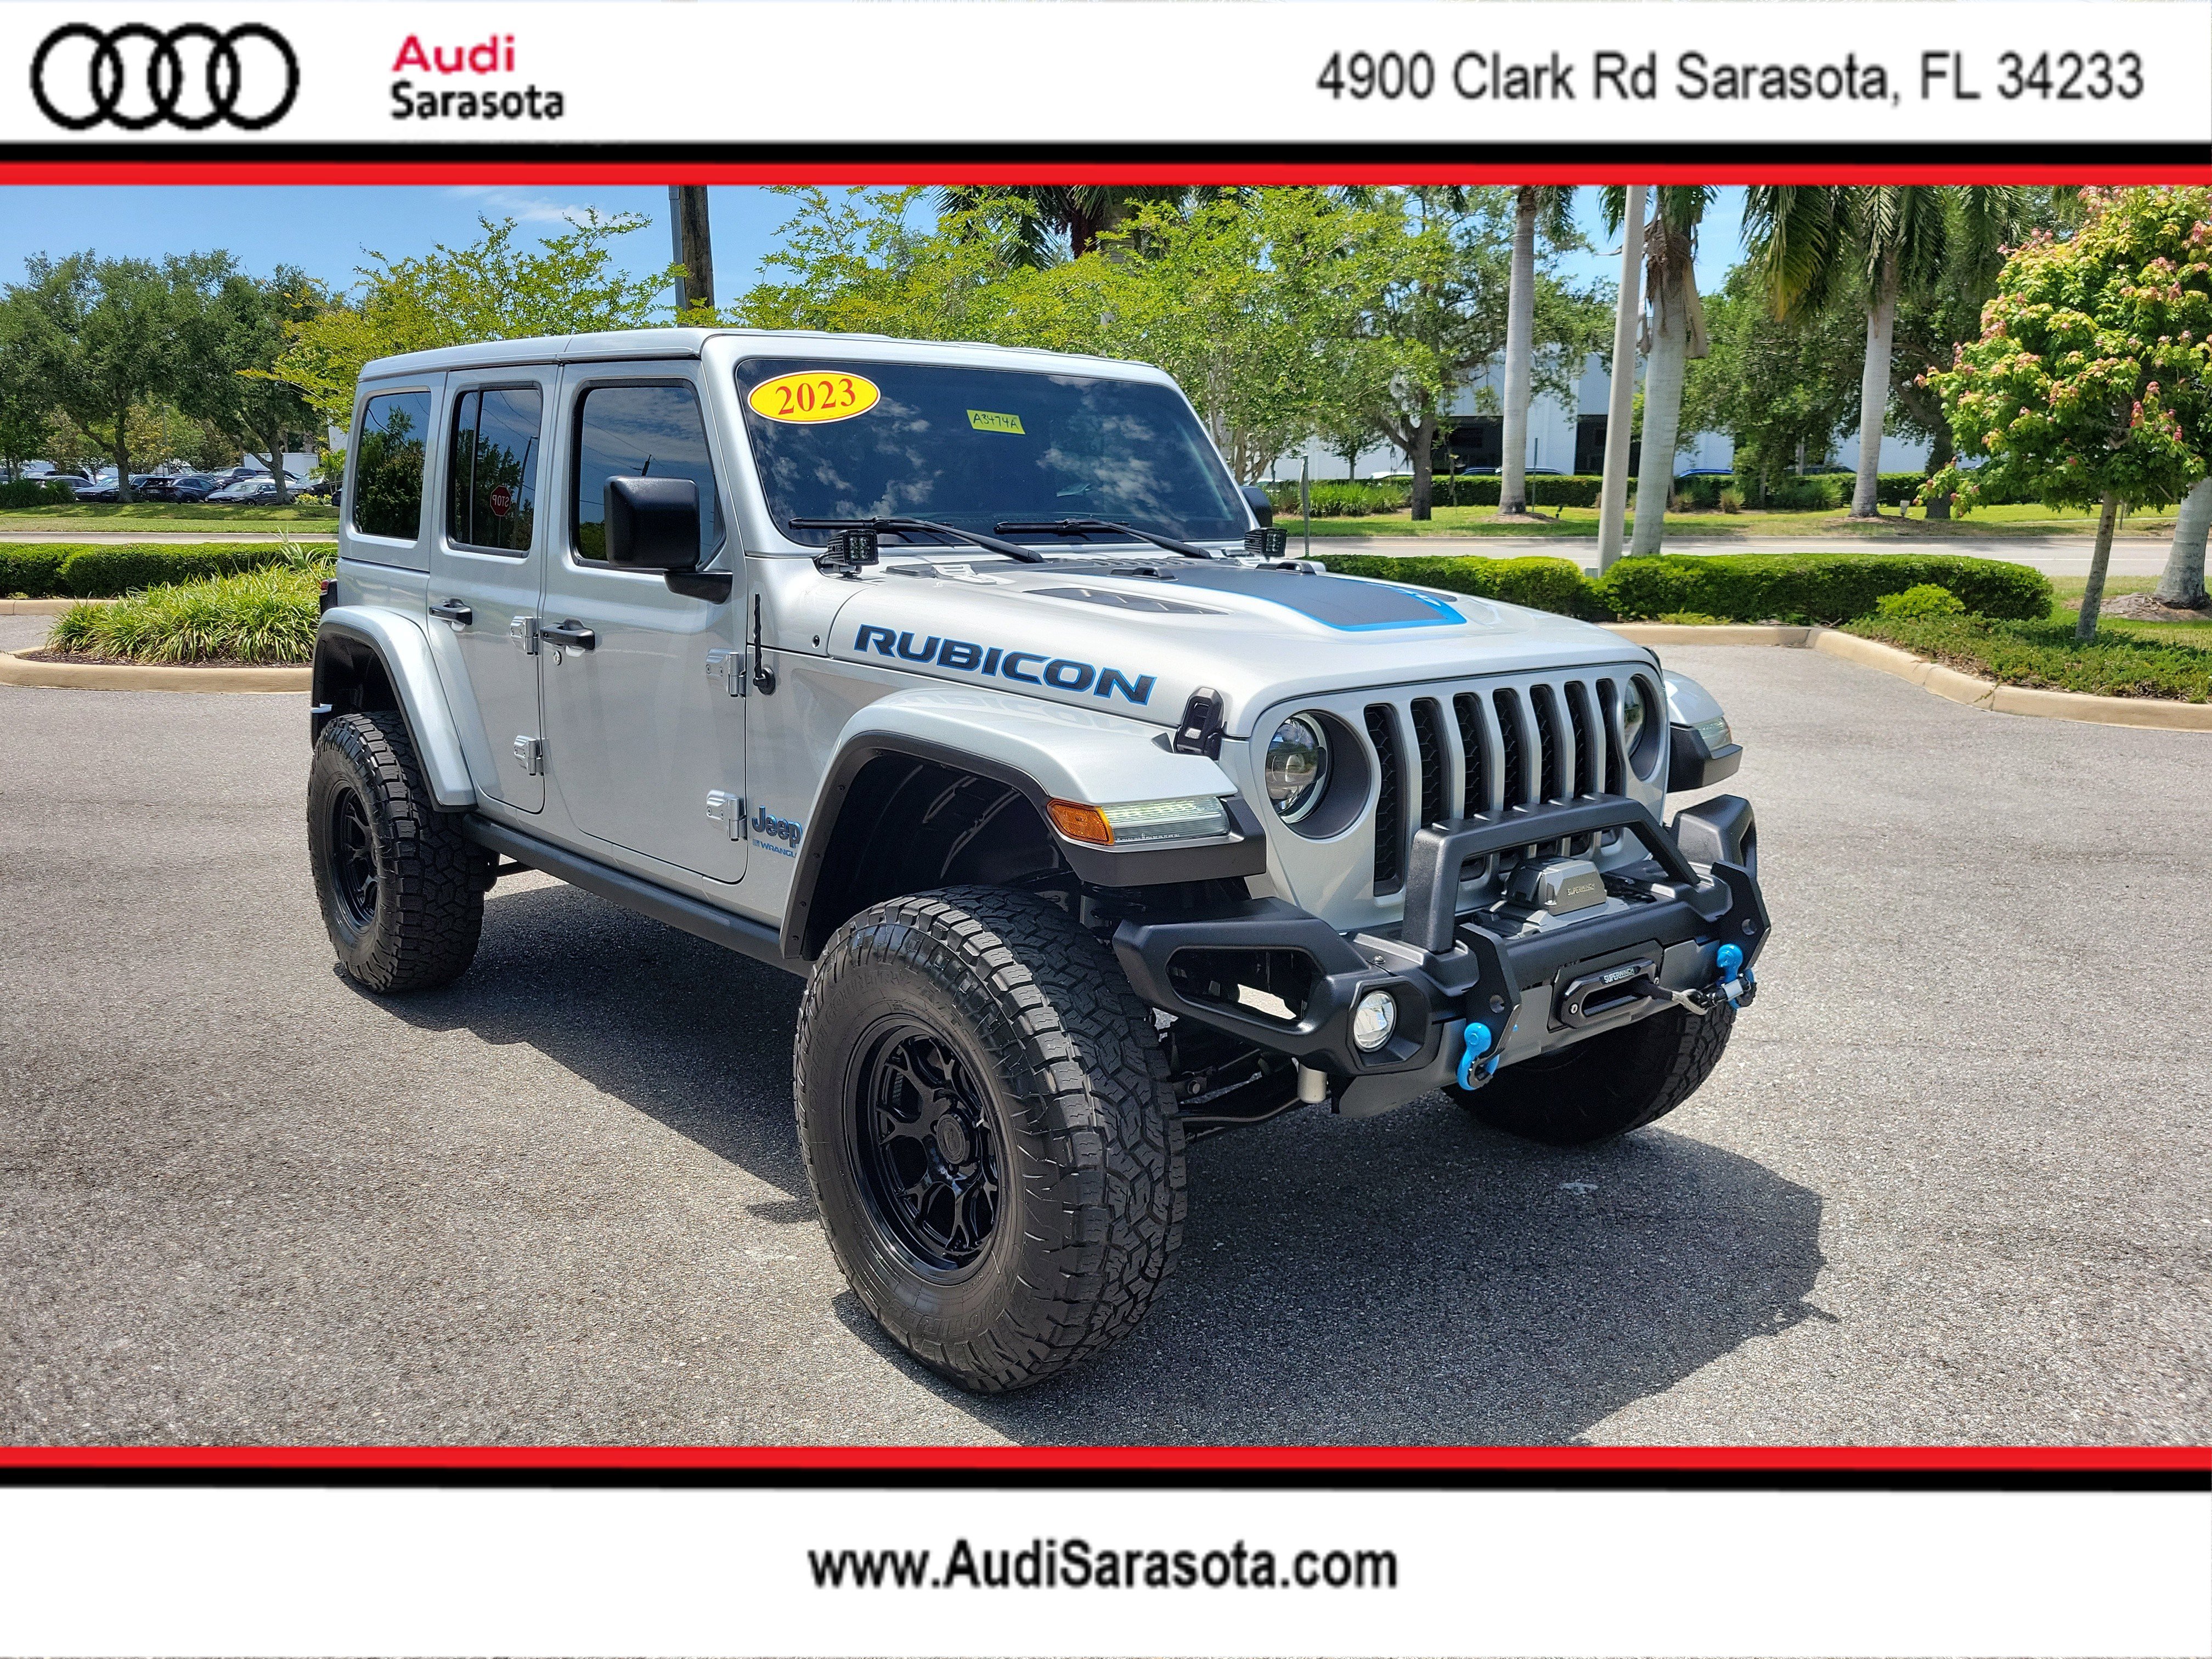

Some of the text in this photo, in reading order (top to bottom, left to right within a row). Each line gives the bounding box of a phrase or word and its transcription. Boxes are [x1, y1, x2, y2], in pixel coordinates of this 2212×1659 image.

[776, 379, 855, 415] 2023
[973, 413, 1019, 430] A3474A
[854, 624, 1157, 706] RUBICON
[752, 805, 803, 849] Jeep
[760, 841, 797, 858] WRANGL
[1604, 967, 1634, 984] SUPERWINCH
